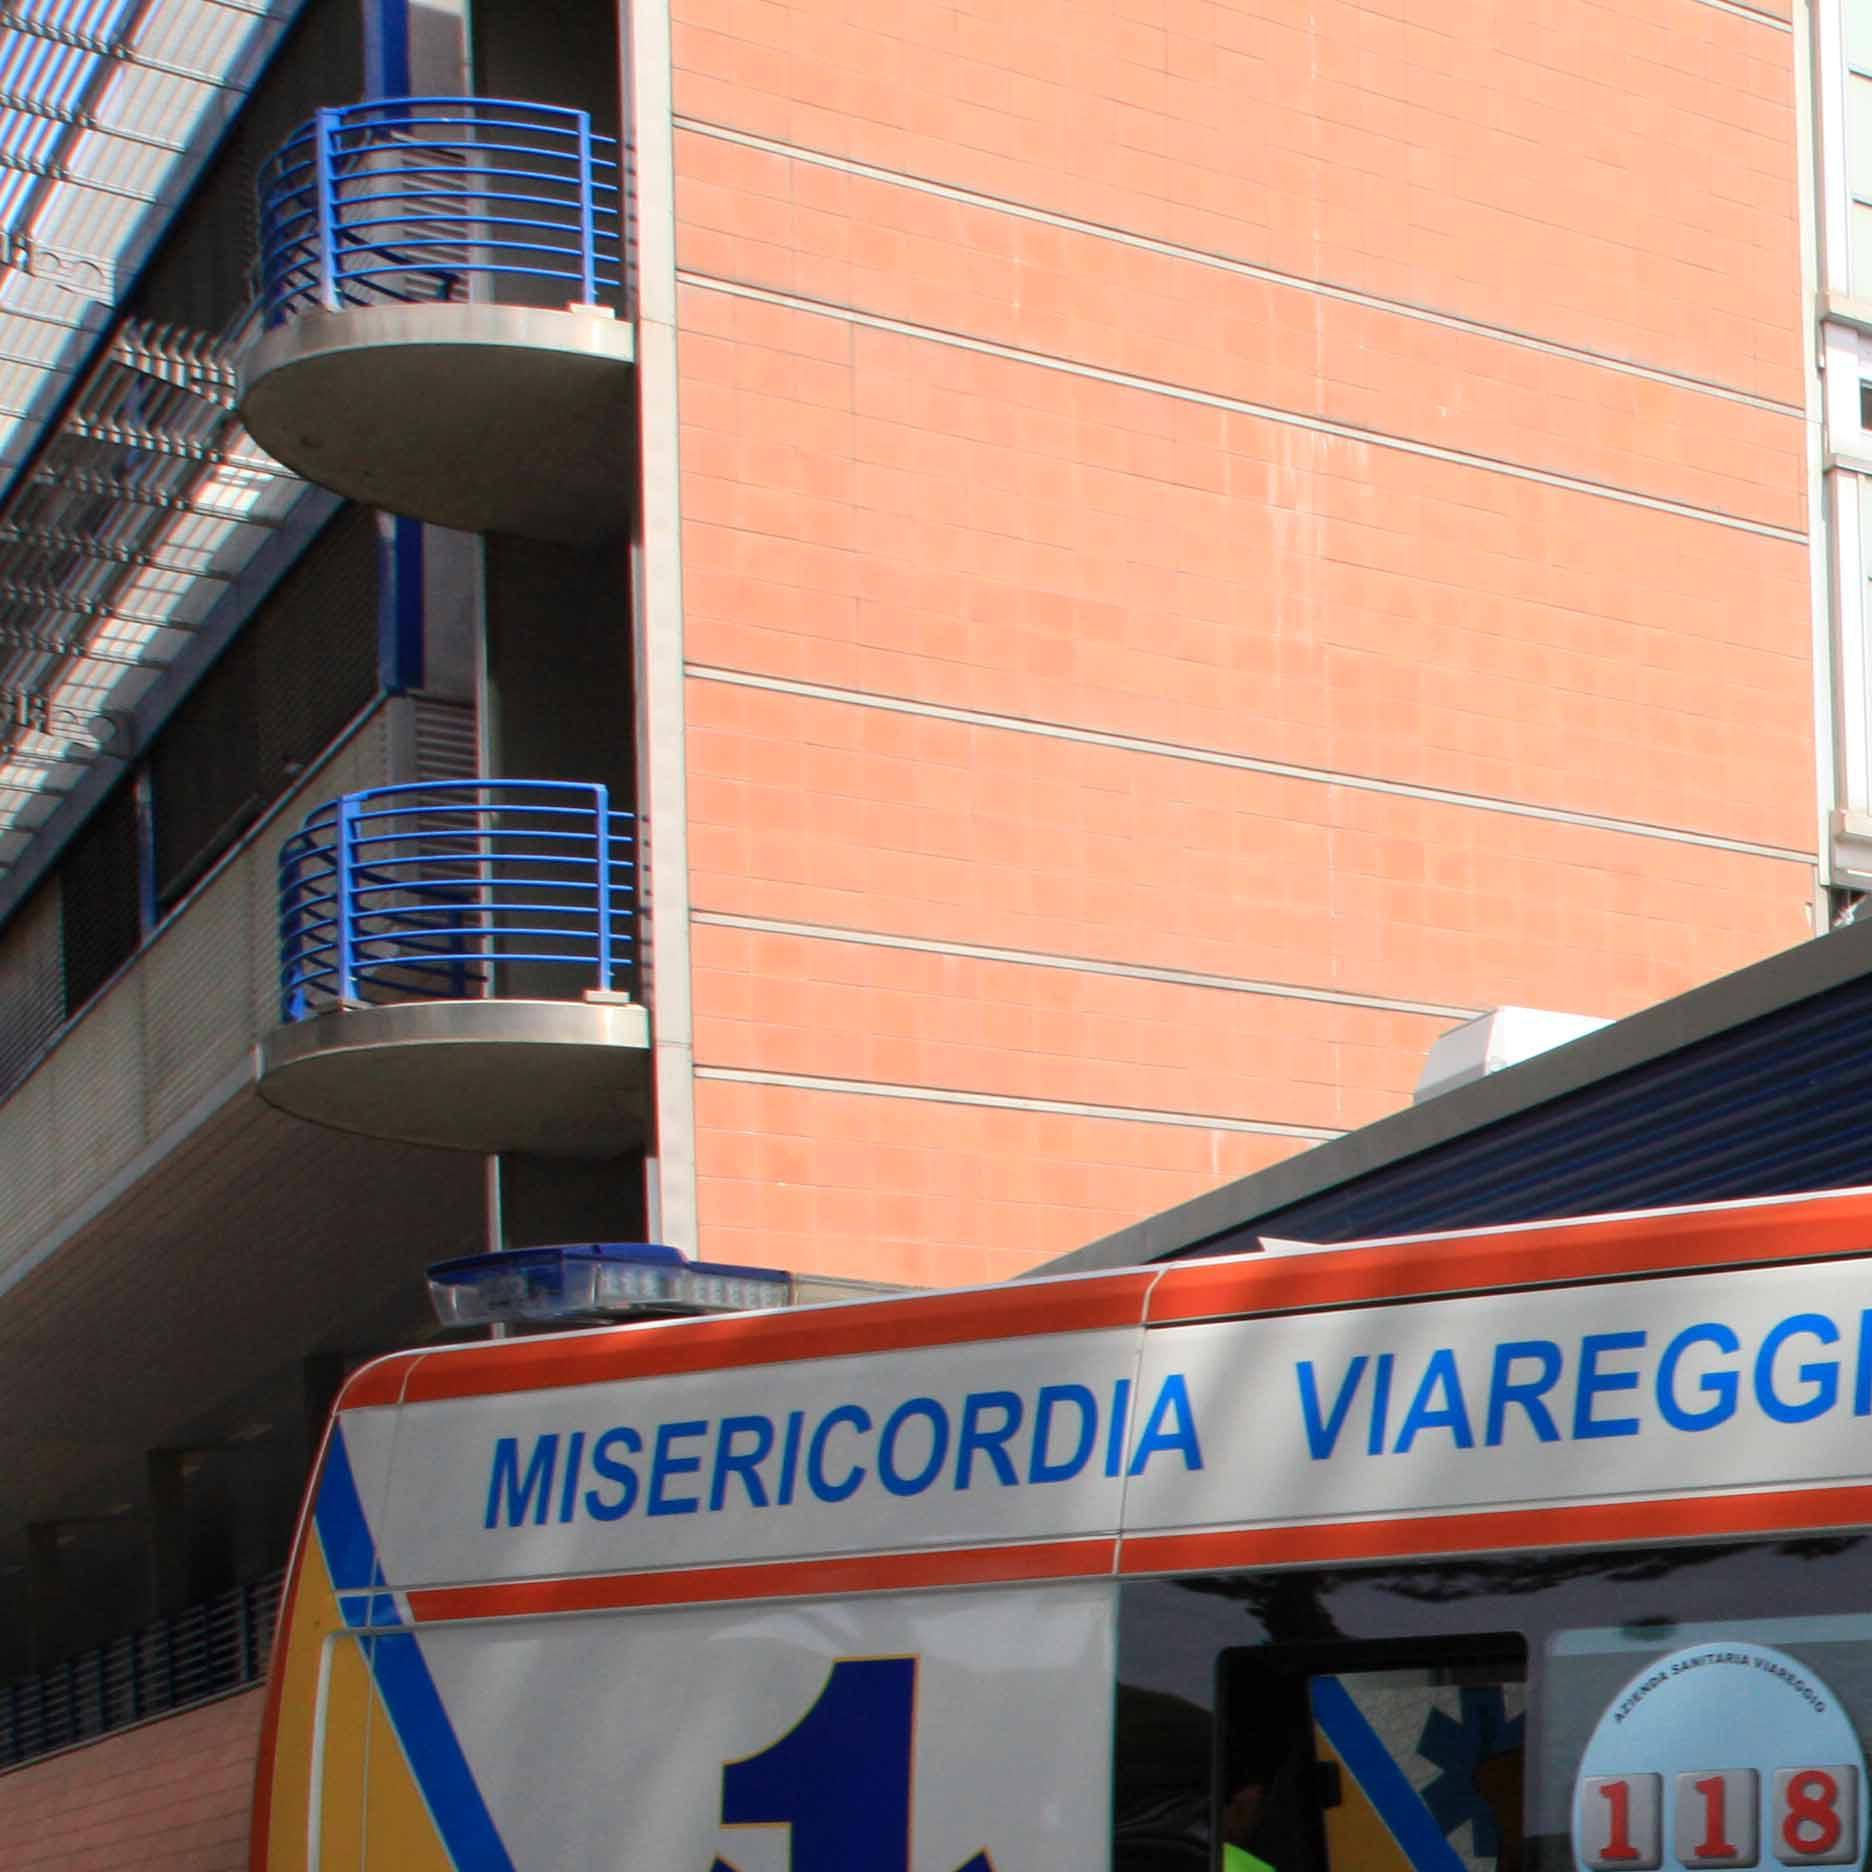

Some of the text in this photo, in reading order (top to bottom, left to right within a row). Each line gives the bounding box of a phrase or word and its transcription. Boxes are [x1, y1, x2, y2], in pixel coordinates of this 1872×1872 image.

[483, 1373, 1205, 1530] MISERICORDIA
[1614, 1652, 1826, 1723] AZIENDA SANITARIA VIAREGGIO
